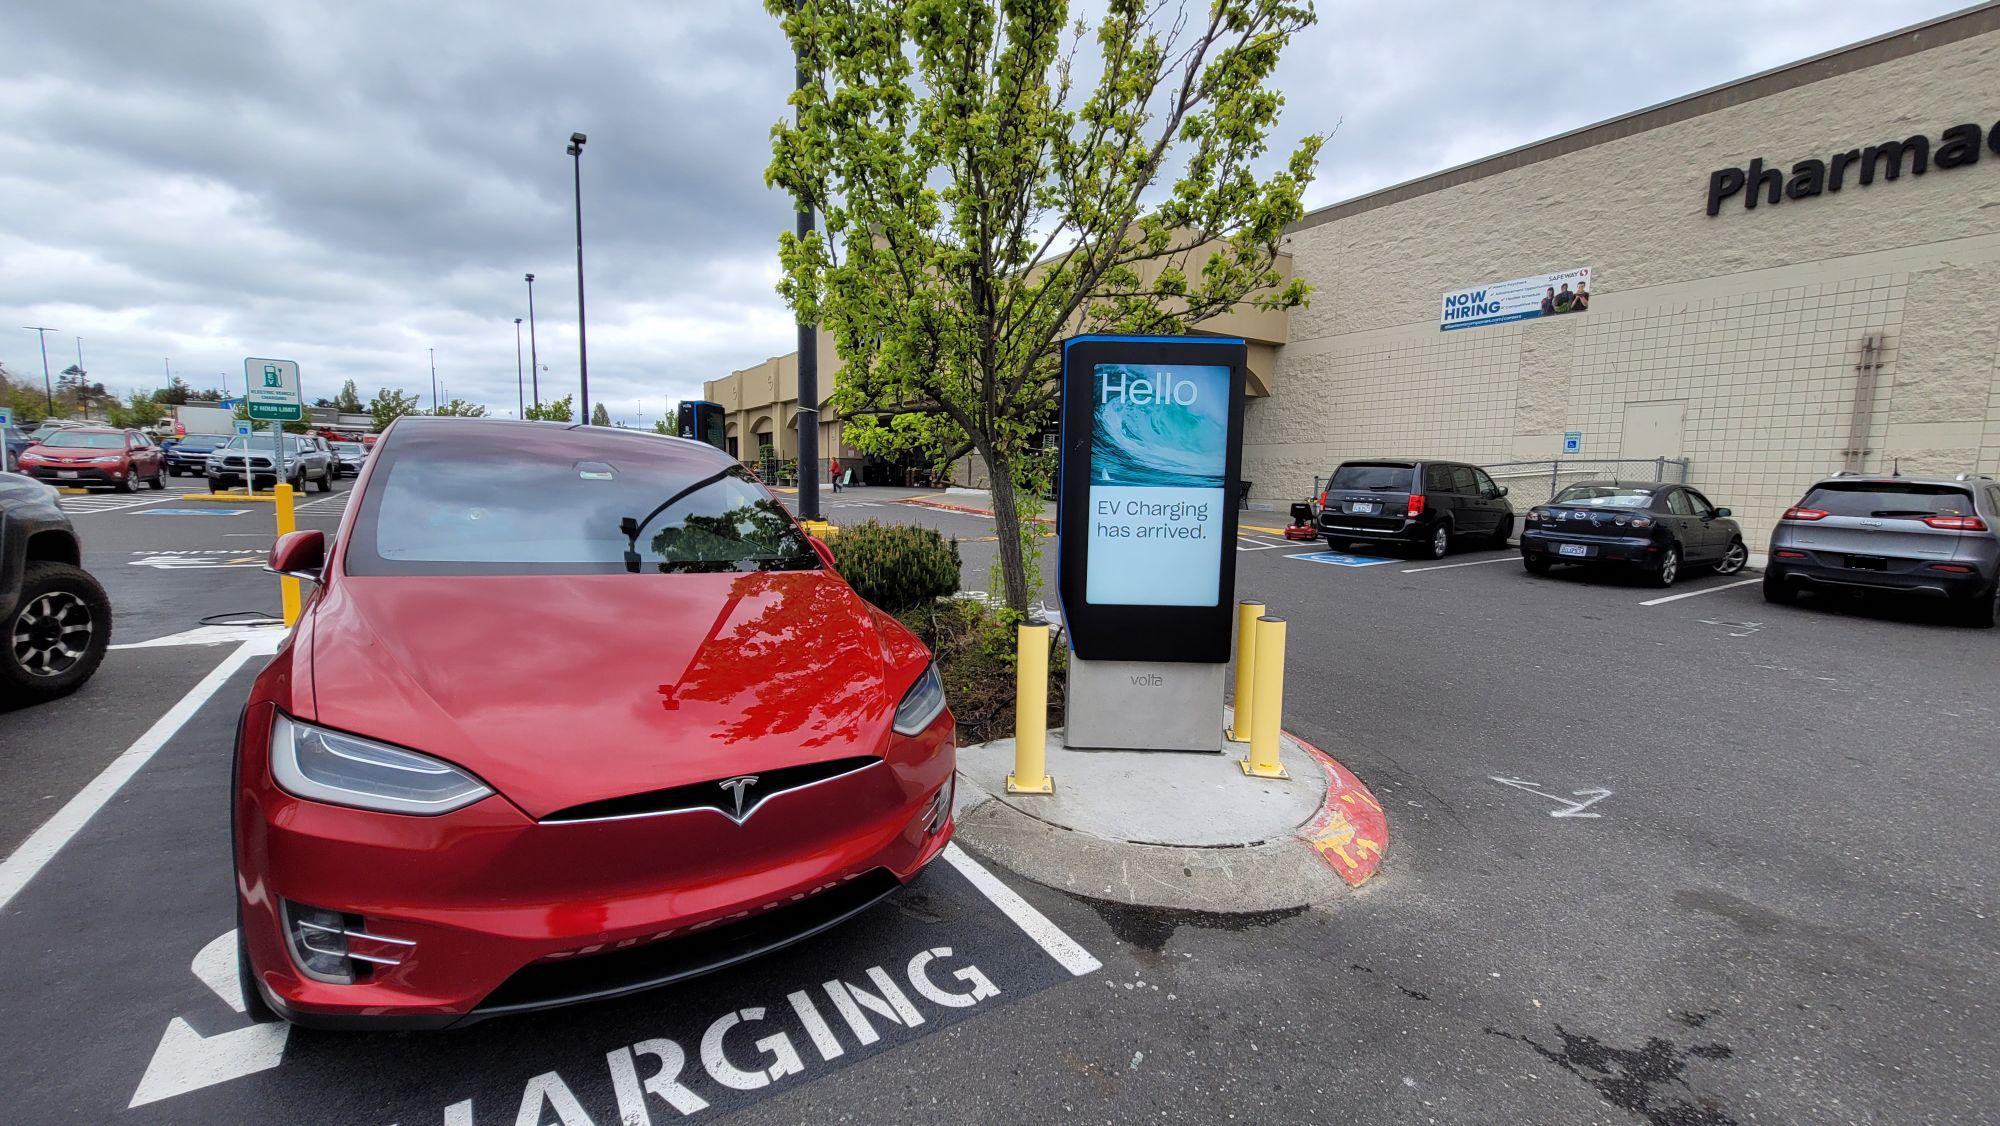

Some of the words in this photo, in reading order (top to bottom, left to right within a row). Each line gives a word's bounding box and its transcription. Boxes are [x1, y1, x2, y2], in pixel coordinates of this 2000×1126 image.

[1548, 271, 1579, 282] SAFEWAY
[1445, 290, 1487, 308] NOW
[1444, 301, 1501, 321] HIRING
[1101, 372, 1198, 406] Hello
[1098, 500, 1121, 515] EV
[1126, 501, 1208, 521] Charging
[1097, 522, 1130, 538] has
[1136, 523, 1206, 540] arrived.
[1130, 673, 1163, 687] volta
[443, 946, 1002, 1126] ARGING
